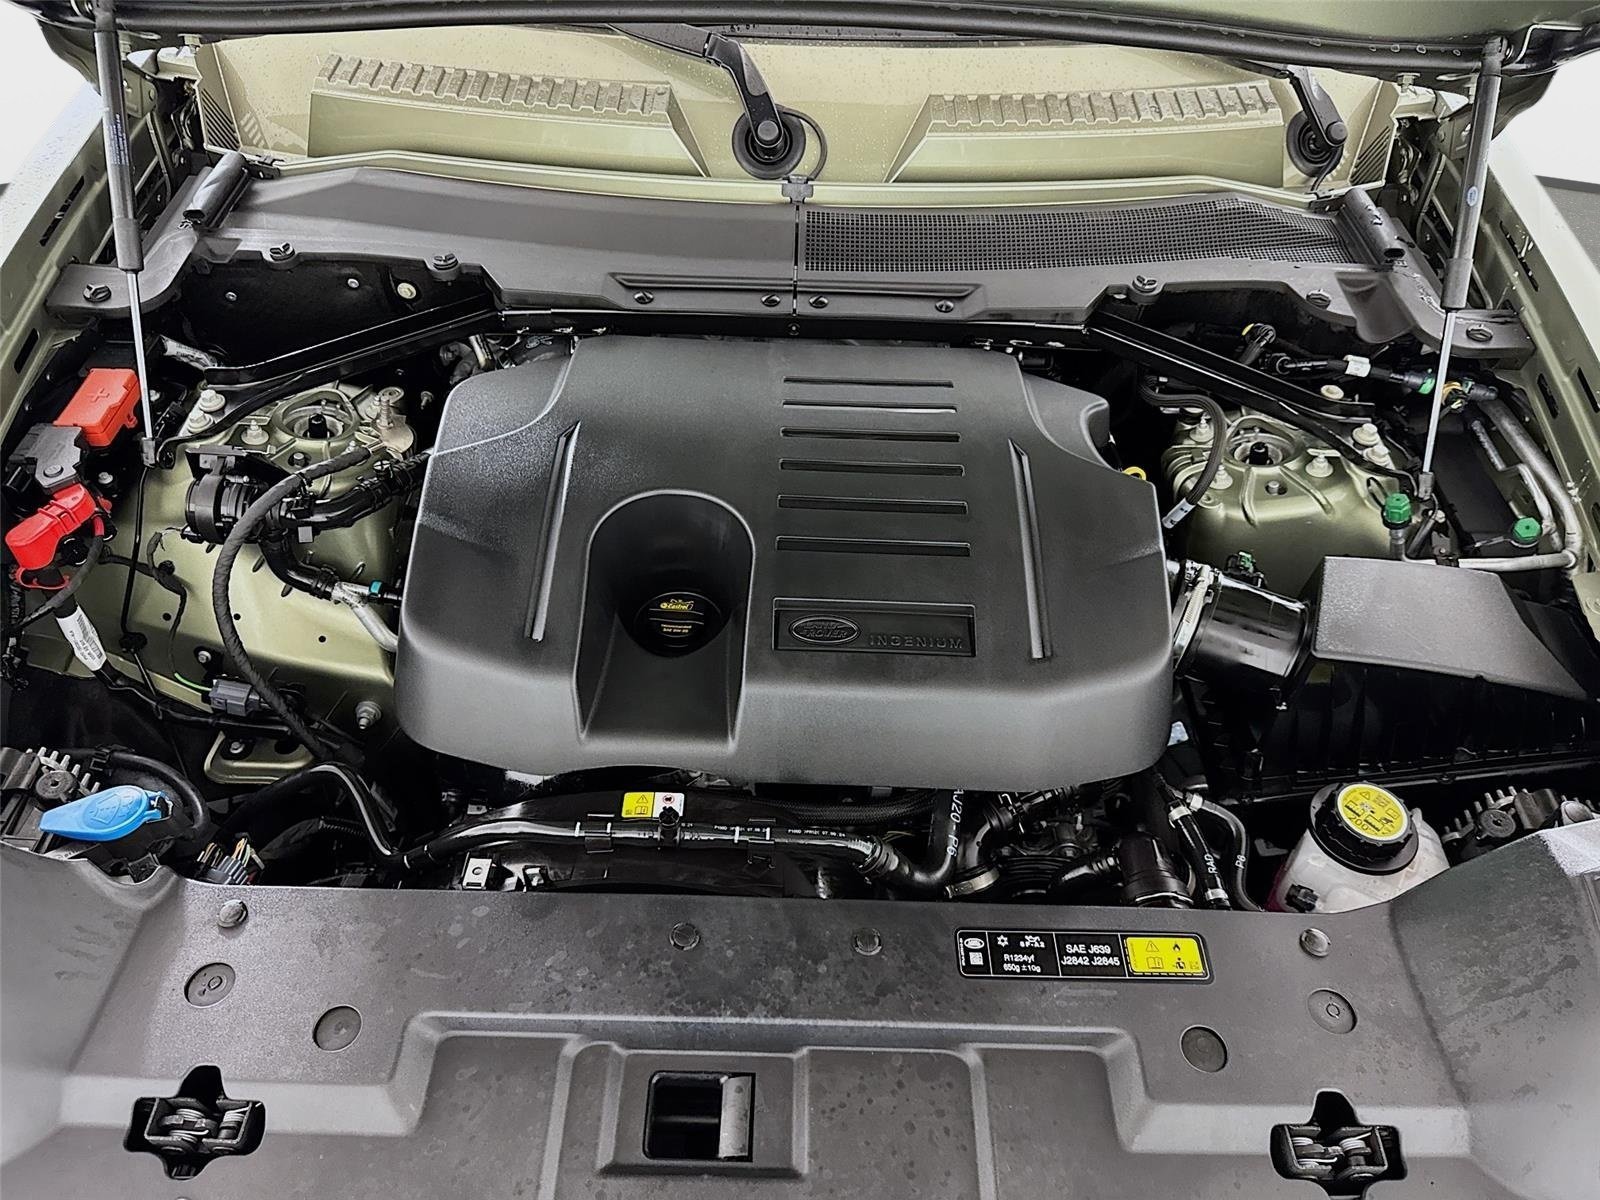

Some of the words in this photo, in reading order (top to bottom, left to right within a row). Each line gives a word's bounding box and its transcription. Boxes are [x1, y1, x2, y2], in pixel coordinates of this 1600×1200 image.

[869, 634, 963, 649] INGENIUM
[1348, 815, 1369, 831] 200
[1204, 853, 1218, 874] RAD
[1235, 854, 1246, 869] P6
[1065, 944, 1087, 954] SAE
[1088, 944, 1112, 954] J639
[1003, 953, 1035, 964] R1234yf
[1061, 955, 1090, 966] J2842
[1091, 956, 1120, 966] J2845
[1003, 962, 1021, 973] 650g
